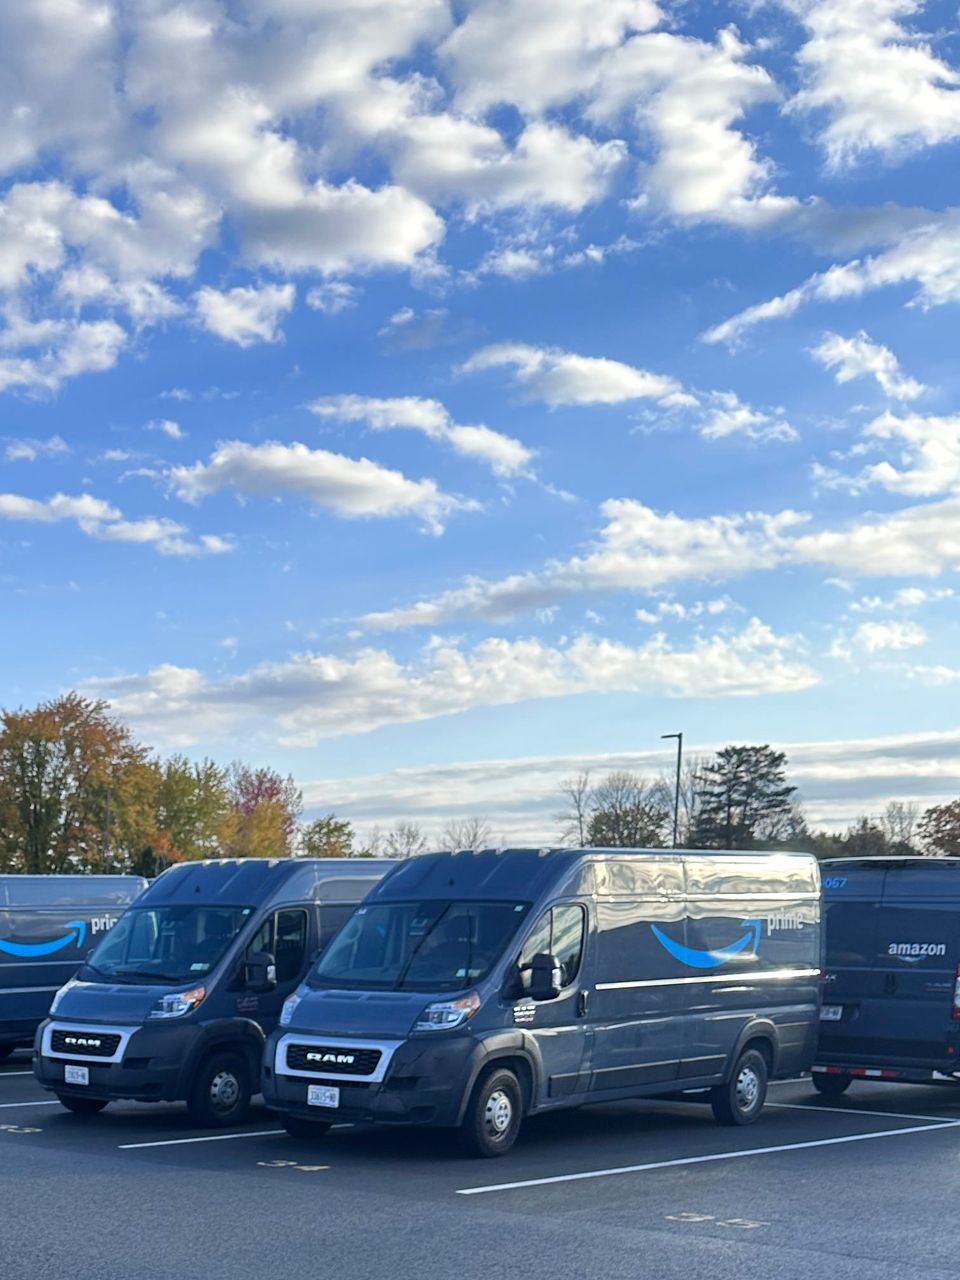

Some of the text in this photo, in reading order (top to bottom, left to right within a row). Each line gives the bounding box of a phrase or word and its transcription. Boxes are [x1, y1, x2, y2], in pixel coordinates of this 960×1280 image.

[91, 913, 118, 935] pri
[767, 908, 804, 936] prime
[888, 942, 946, 956] amazon
[65, 1037, 102, 1047] RAM
[306, 1052, 355, 1064] RAM
